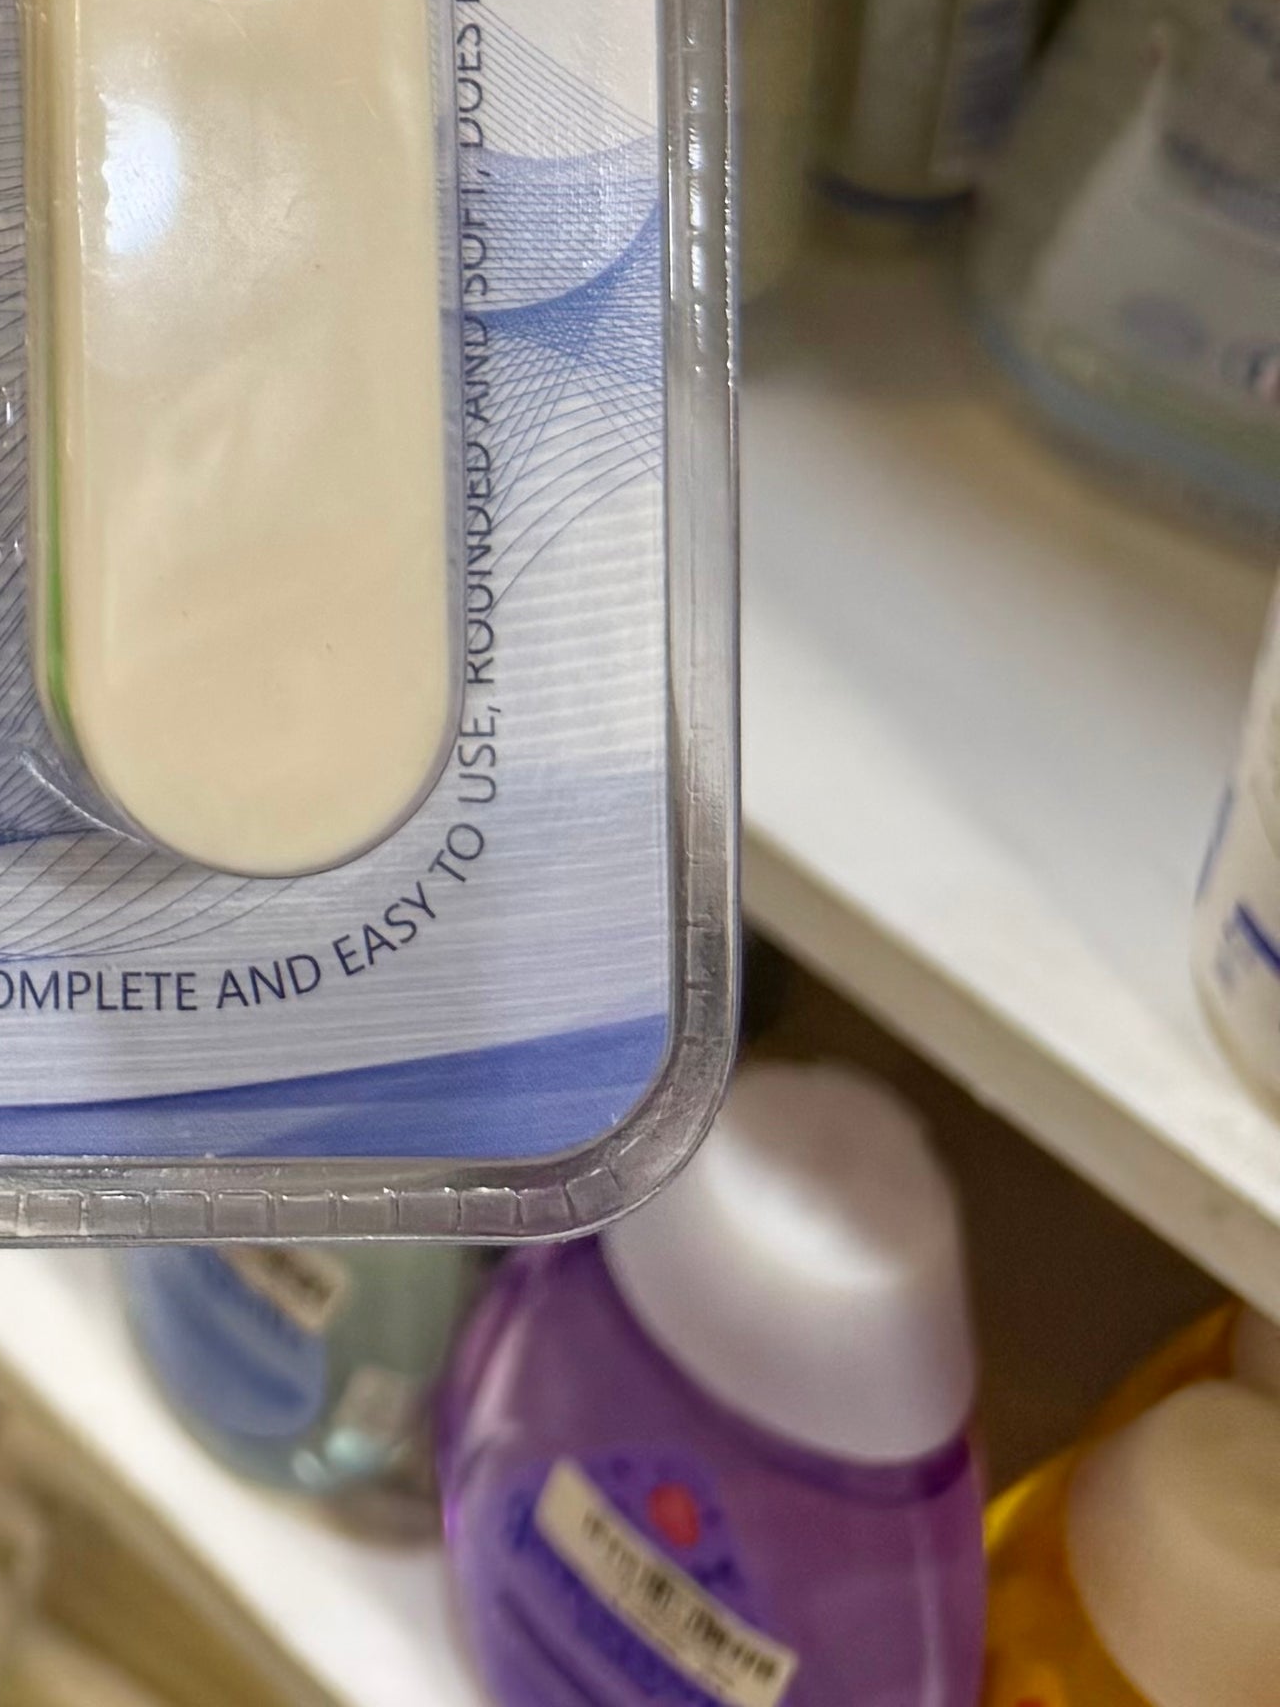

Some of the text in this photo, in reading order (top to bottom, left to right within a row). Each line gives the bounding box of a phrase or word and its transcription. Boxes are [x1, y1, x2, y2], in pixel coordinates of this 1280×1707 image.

[457, 22, 485, 149] DOES
[463, 315, 492, 424] AND
[466, 440, 496, 686] ROUNDED
[457, 705, 502, 804] USE,
[428, 823, 486, 883] TO
[332, 880, 437, 977] EASY
[216, 953, 322, 1009] AND
